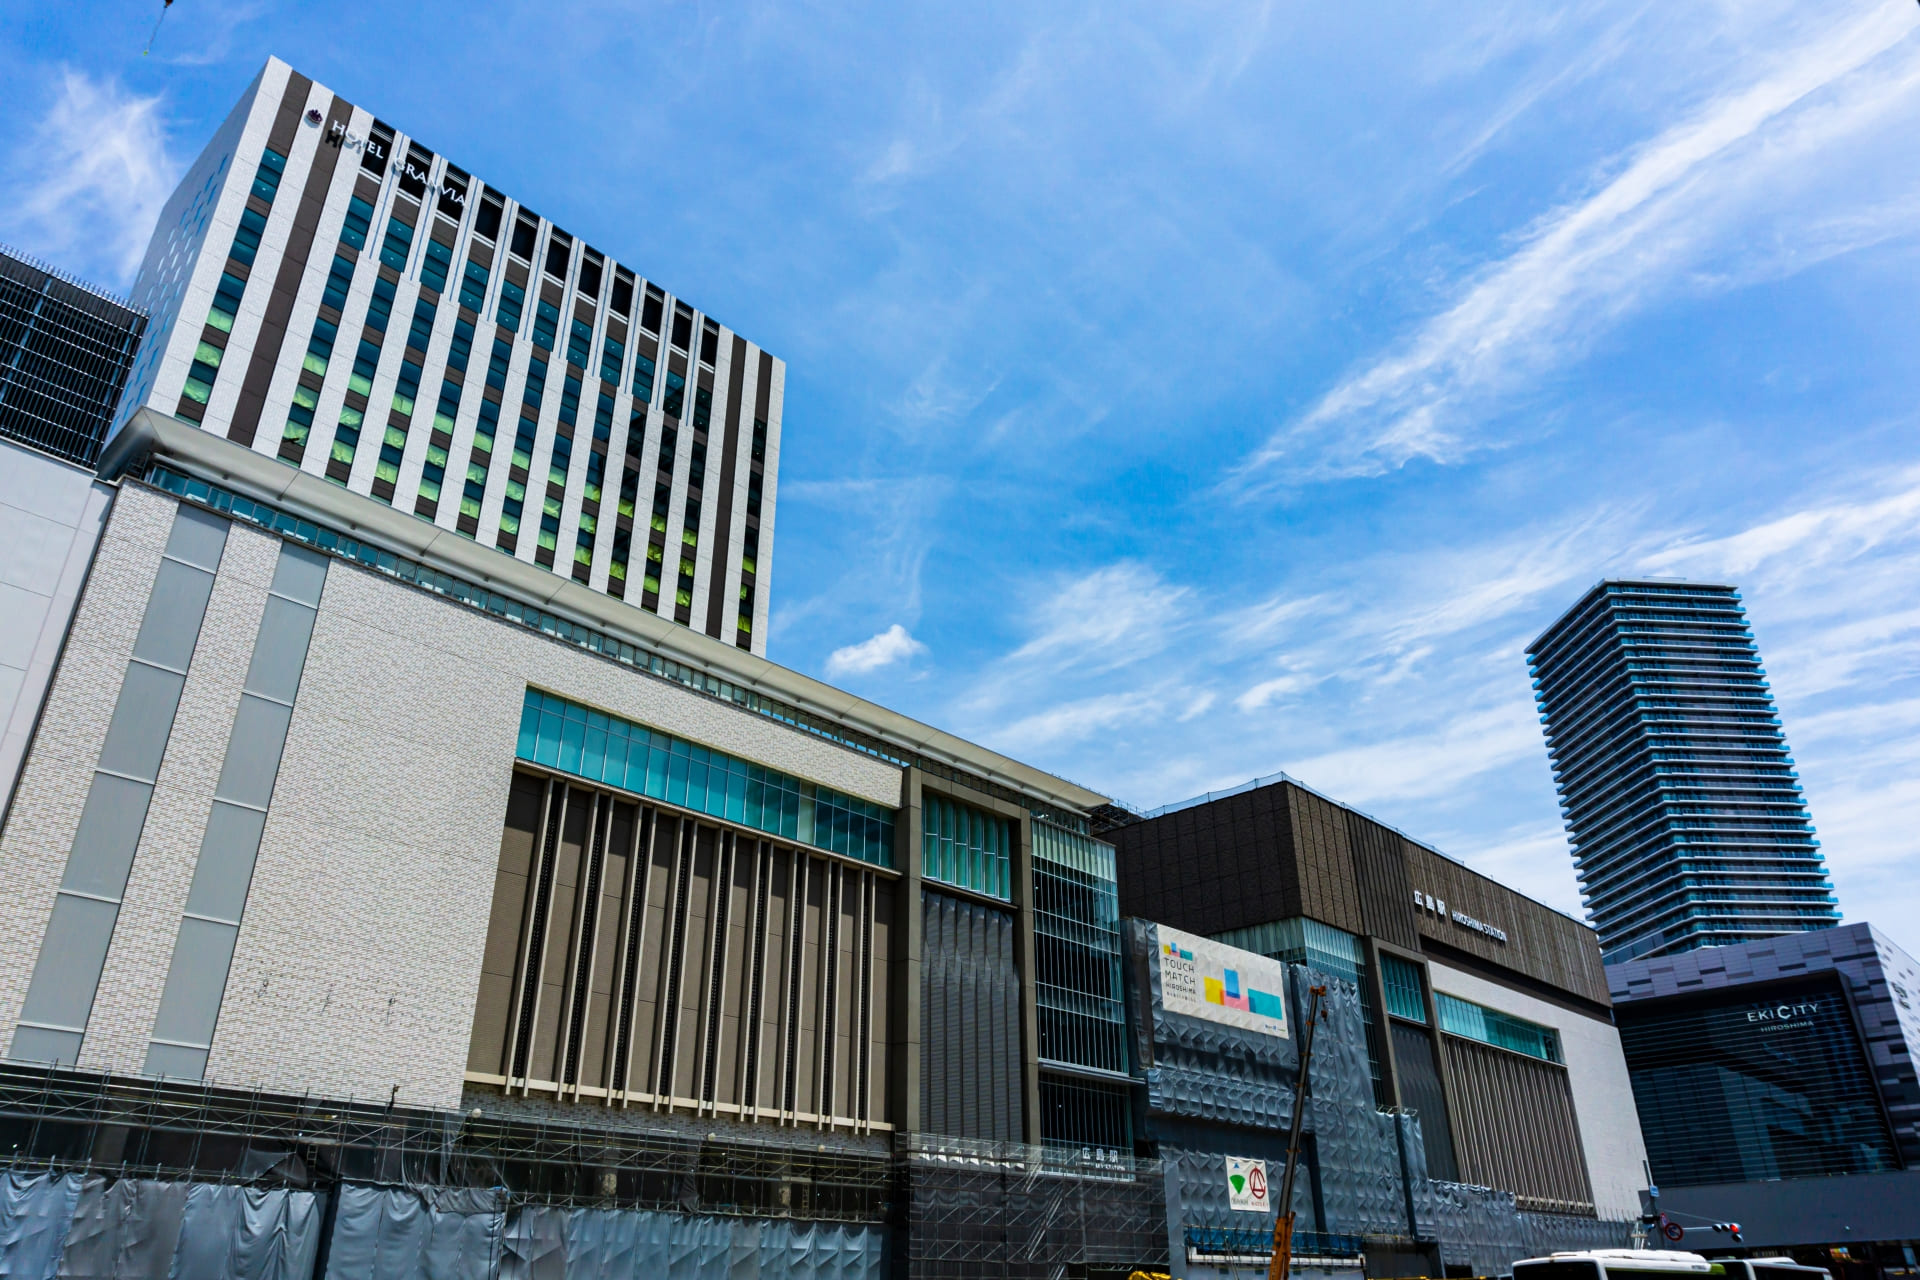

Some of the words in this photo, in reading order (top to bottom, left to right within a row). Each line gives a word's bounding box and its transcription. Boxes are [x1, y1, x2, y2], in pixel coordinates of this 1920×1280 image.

[332, 120, 384, 159] HOTEL
[394, 158, 466, 206] GRANVIA
[1414, 890, 1446, 916] 広島駅
[1452, 909, 1484, 932] HIROSHIMA
[1483, 923, 1507, 942] STATION
[1164, 957, 1195, 974] TOUCH
[1165, 970, 1196, 985] MATCH
[1165, 983, 1196, 995] HIROSHIMA
[1760, 1021, 1814, 1032] HIROSHIMA
